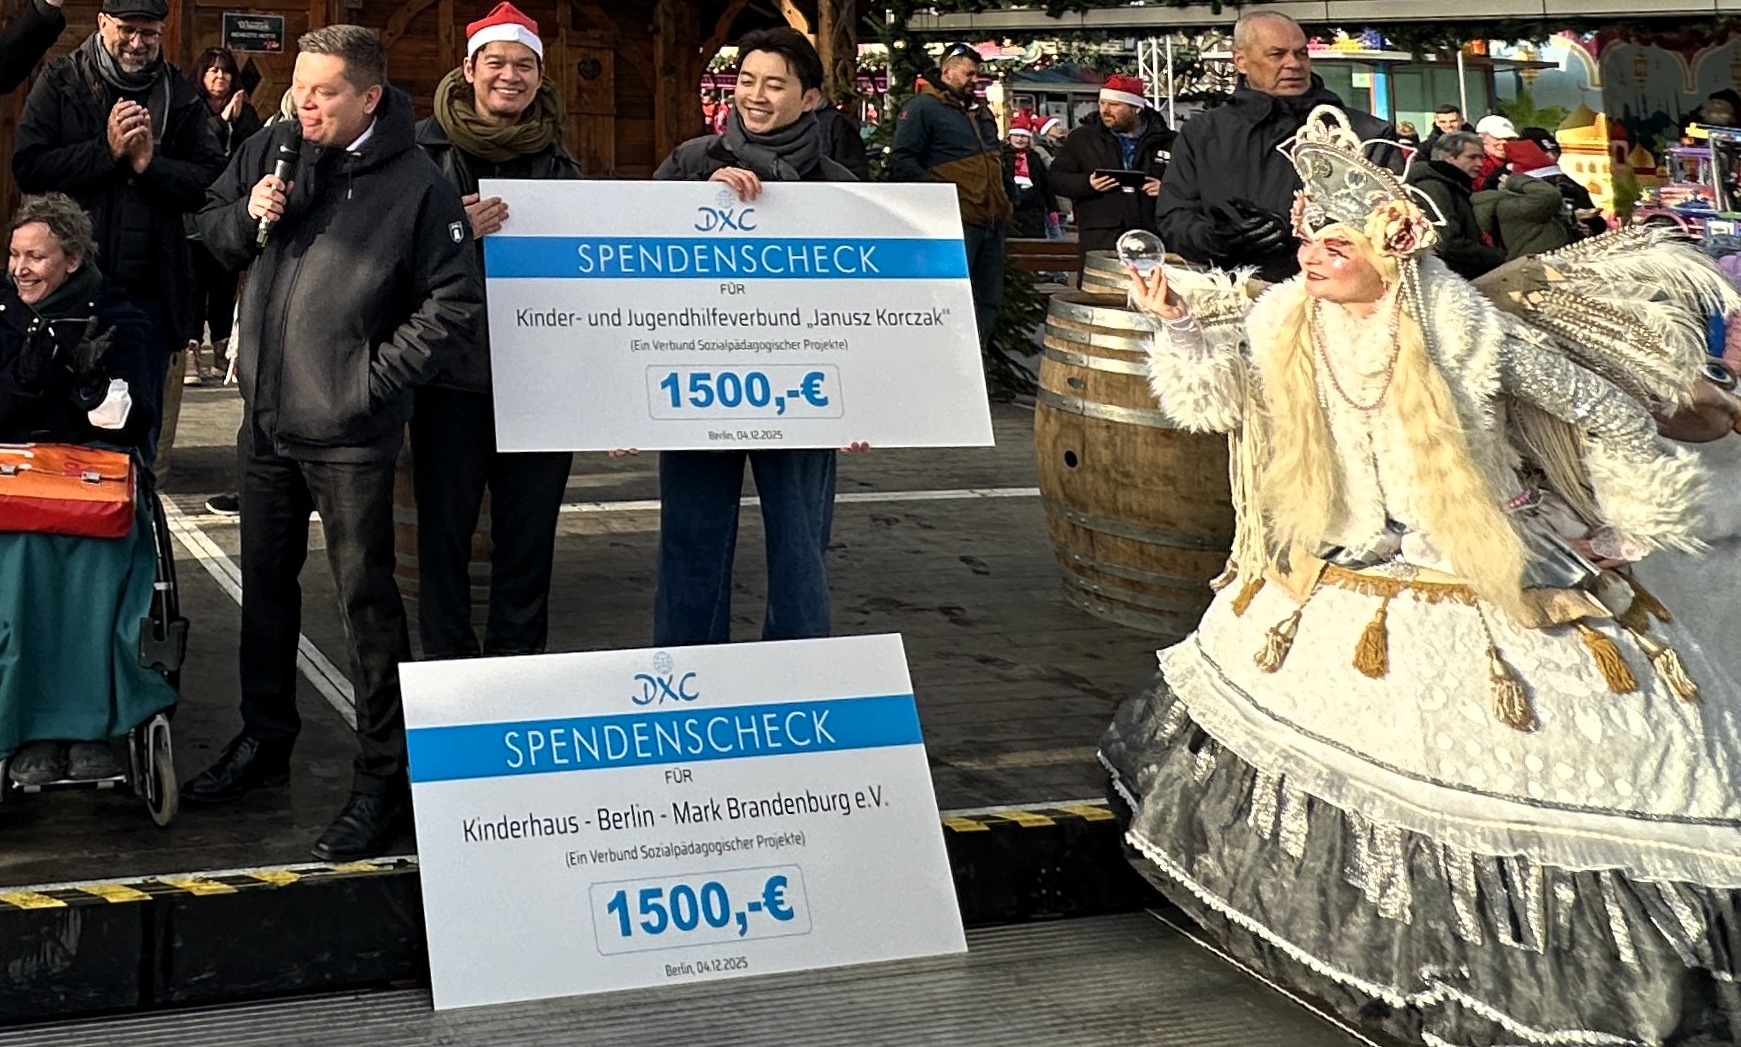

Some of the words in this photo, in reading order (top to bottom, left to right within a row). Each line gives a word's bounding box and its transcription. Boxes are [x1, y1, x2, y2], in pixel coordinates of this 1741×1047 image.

[694, 207, 758, 233] DXC
[577, 244, 880, 273] SPENDENSCHECK
[720, 282, 745, 295] FÜR
[516, 309, 583, 328] Kinder-
[588, 309, 621, 328] und
[627, 308, 801, 333] Jugendhilfeverbund
[807, 308, 872, 330] „Janusz
[630, 339, 649, 353] (Ein
[652, 340, 695, 351] Verbund
[697, 340, 801, 354] Sozialpädagogischer
[804, 340, 848, 354] Projekte)
[660, 371, 829, 415] 1500,-€
[708, 431, 735, 441] Berlin,
[737, 430, 783, 441] 04.12.2025
[632, 672, 700, 706] DXC
[504, 709, 836, 769] SPENDENSCHECK
[664, 768, 693, 785] FÜR
[463, 815, 579, 844] Kinderhaus
[598, 806, 655, 832] Berlin
[673, 800, 722, 825] Mark
[728, 790, 852, 821] Brandenburg
[856, 785, 890, 811] e.V.
[565, 849, 588, 869] (Ein
[590, 844, 638, 864] Verbund
[640, 835, 754, 861] Sozialpädagogischer
[756, 830, 806, 851] Projekte)
[607, 875, 795, 938] 1500,-€
[665, 962, 695, 978] Berlin,
[697, 956, 749, 973] 04.12.2025
